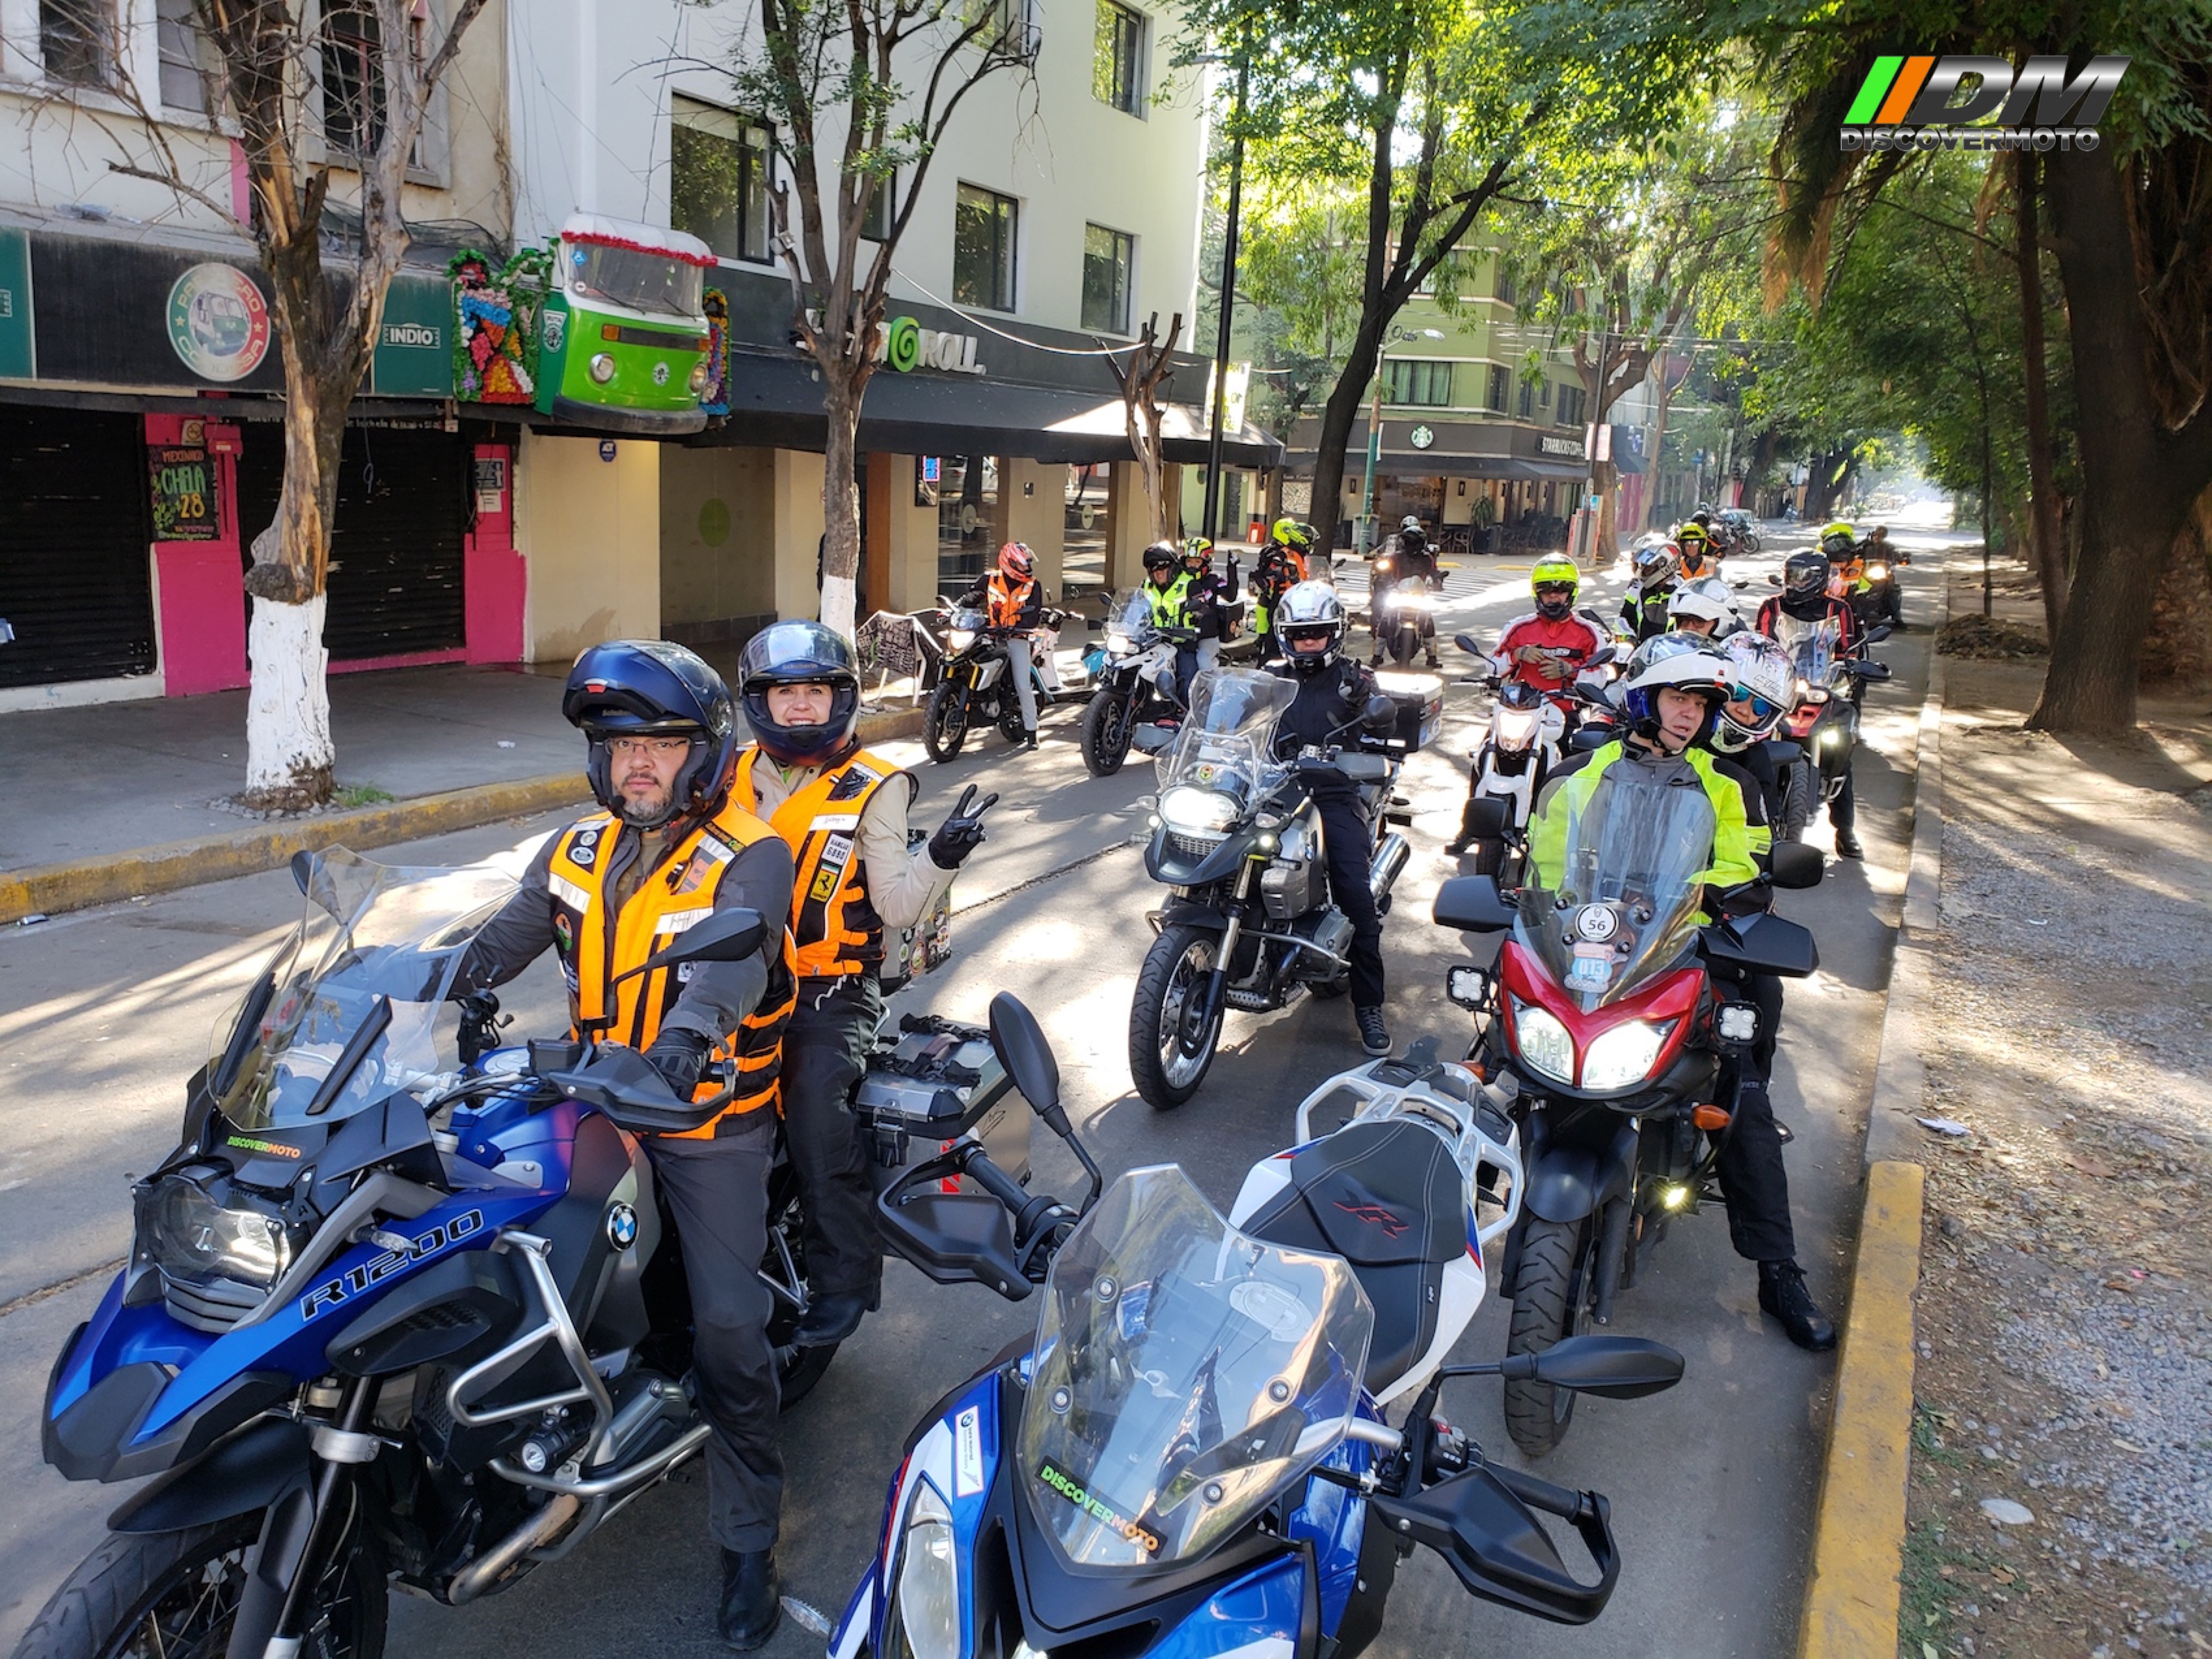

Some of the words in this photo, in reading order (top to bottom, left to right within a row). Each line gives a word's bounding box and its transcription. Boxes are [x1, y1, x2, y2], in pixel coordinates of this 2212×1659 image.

[390, 327, 433, 345] INDIO
[1587, 919, 1606, 931] 56
[1579, 958, 1605, 975] 013
[227, 1135, 302, 1159] DISCOVERMOTO
[300, 1208, 485, 1322] R1200
